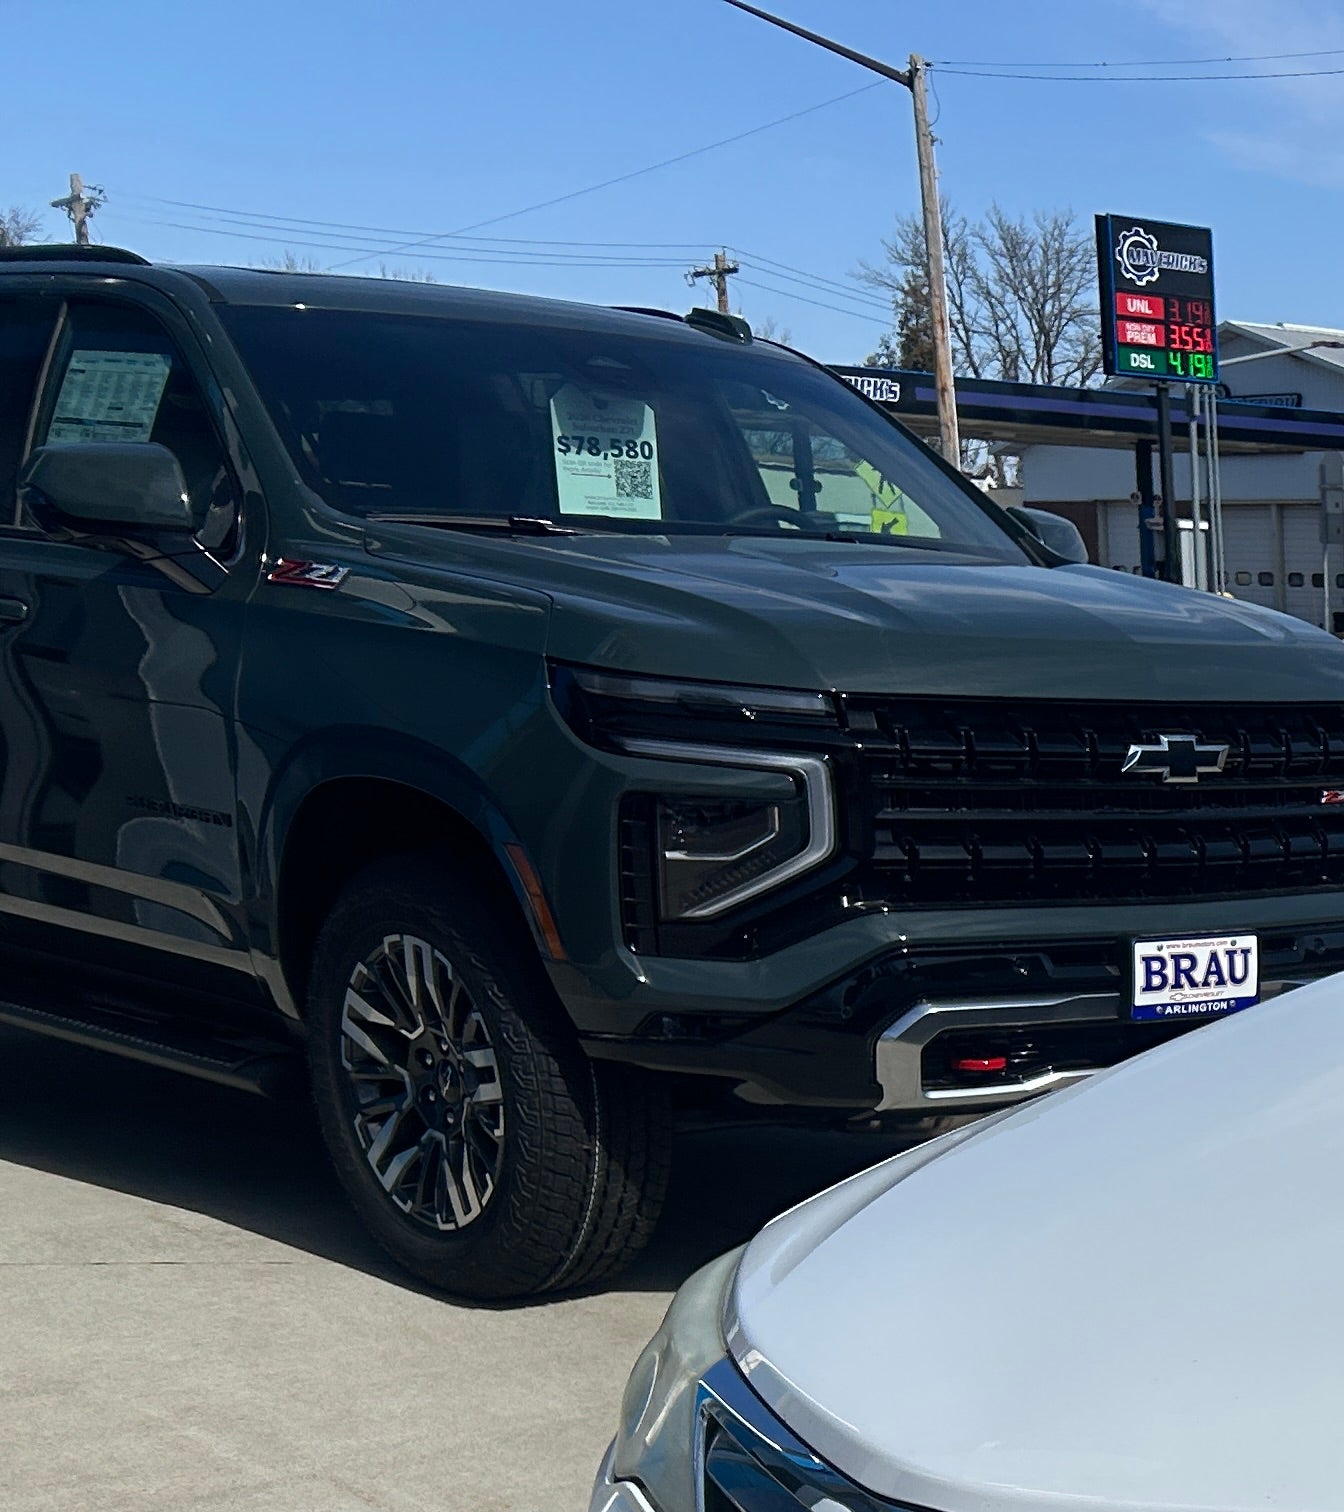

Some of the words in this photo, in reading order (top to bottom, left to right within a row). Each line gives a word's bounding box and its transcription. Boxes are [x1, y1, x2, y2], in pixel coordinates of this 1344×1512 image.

[1127, 298, 1153, 314] UNL
[1126, 331, 1157, 345] PREM
[1130, 353, 1155, 369] DSL
[556, 434, 654, 461] $78,580
[1140, 946, 1253, 995] BRAU
[1164, 1000, 1228, 1015] ARLINGTON
